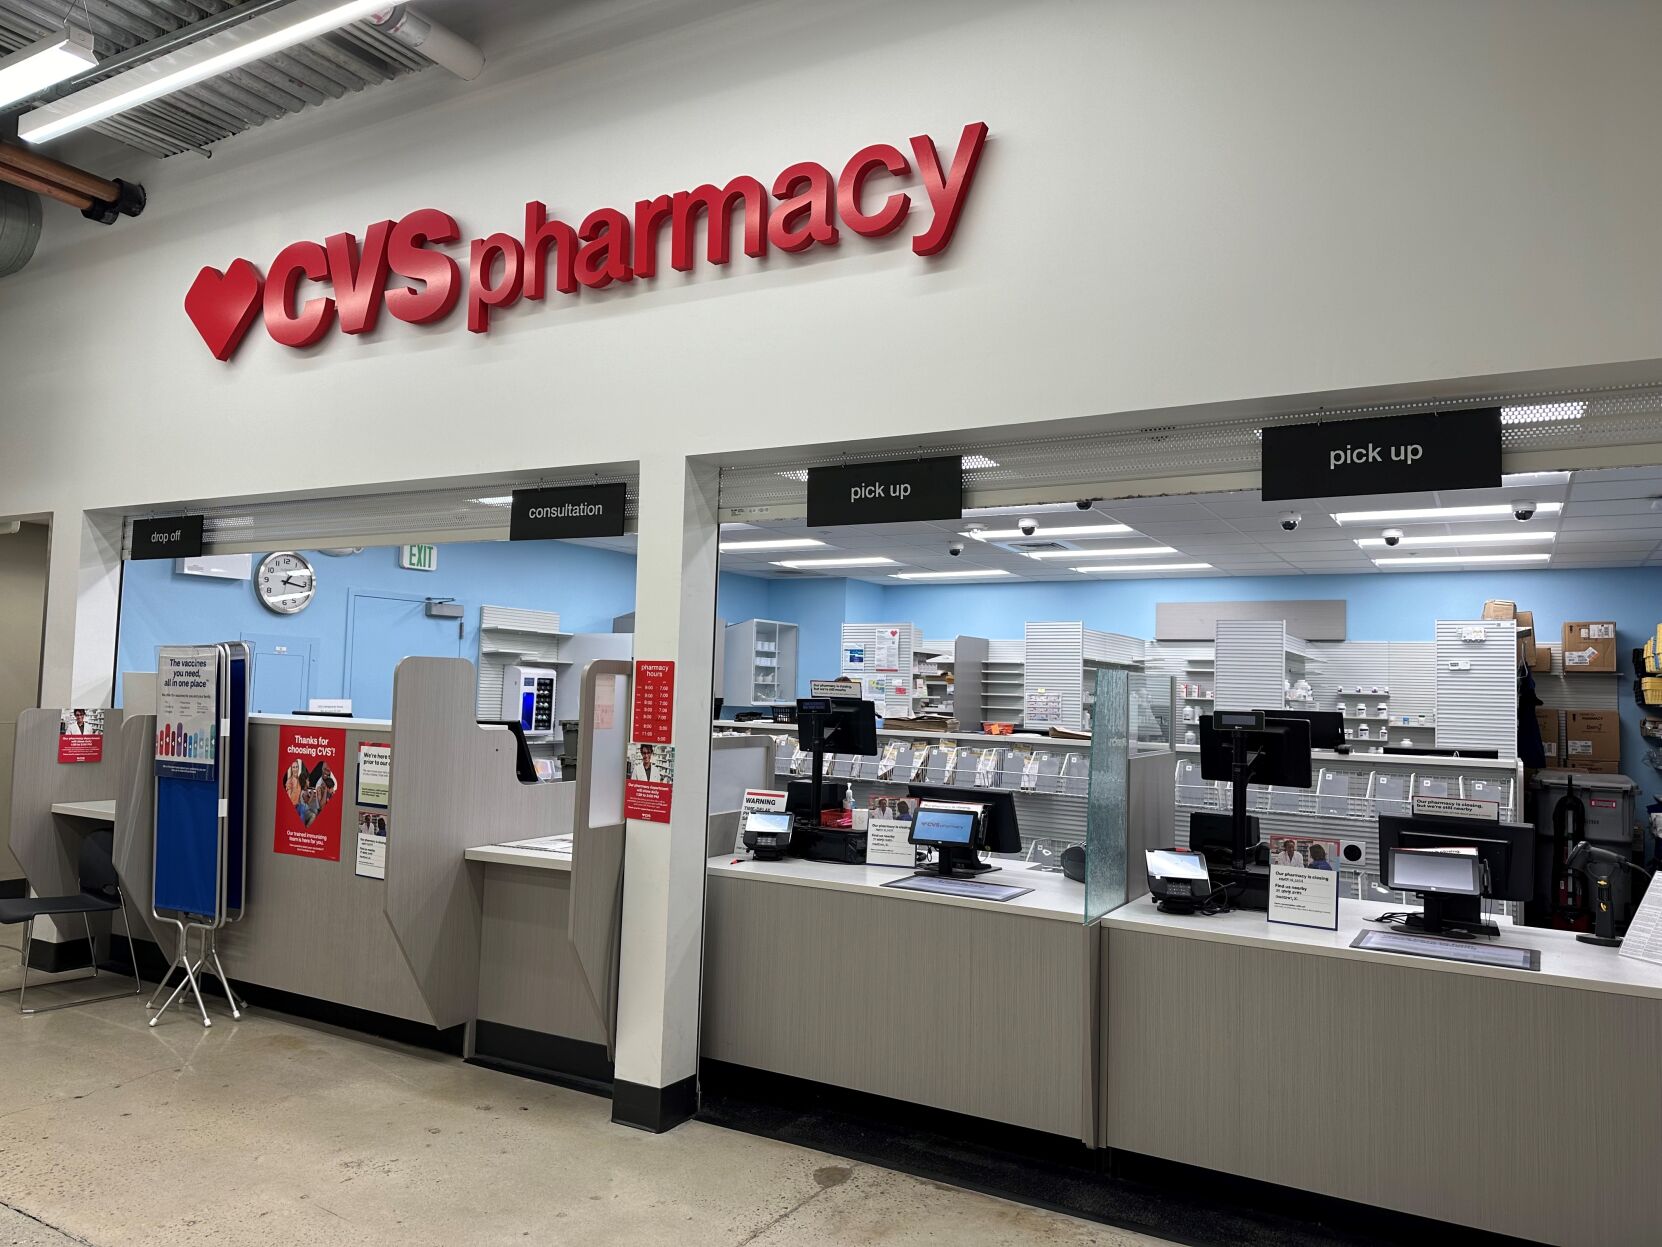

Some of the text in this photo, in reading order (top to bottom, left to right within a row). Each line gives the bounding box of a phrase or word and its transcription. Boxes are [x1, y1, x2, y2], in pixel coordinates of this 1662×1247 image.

[263, 121, 988, 348] CVS pharmacy
[1330, 443, 1423, 470] pick up
[851, 481, 911, 502] pick up
[528, 502, 603, 519] consultation
[151, 530, 181, 544] drop off
[409, 544, 434, 569] EXIT
[170, 658, 207, 668] The vaccines
[640, 664, 669, 672] pharmacy
[173, 669, 201, 680] you need,
[171, 679, 178, 687] in
[178, 680, 190, 688] one
[294, 735, 329, 746] Thanks for
[287, 745, 316, 757] choosing
[745, 797, 776, 806] WARNING
